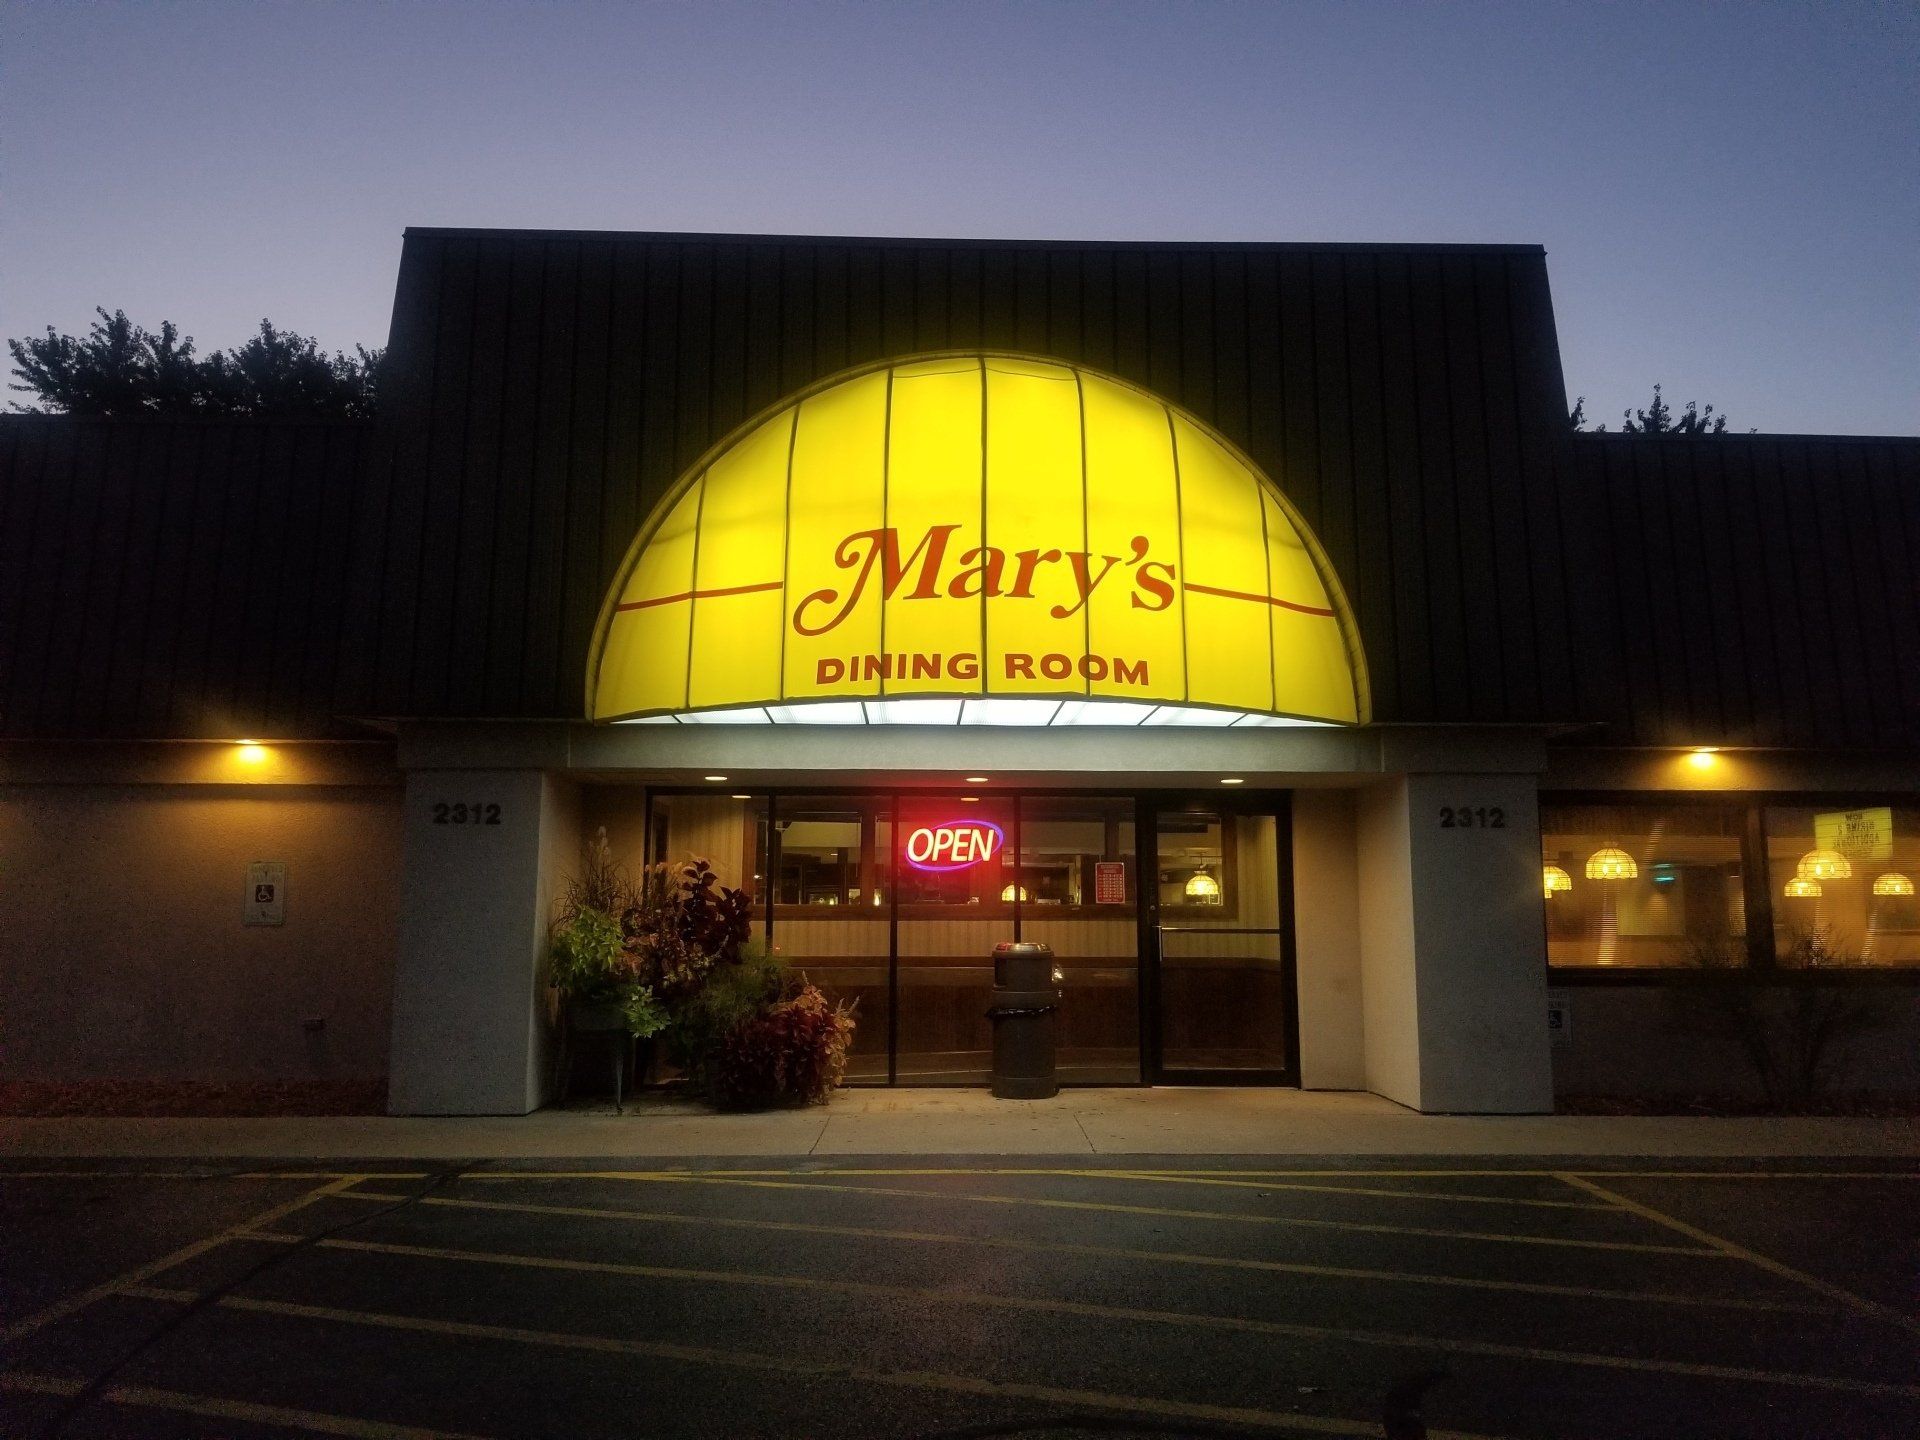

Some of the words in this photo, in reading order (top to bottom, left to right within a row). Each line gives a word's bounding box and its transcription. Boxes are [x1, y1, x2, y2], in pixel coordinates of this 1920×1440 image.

[792, 524, 1176, 637] Mary's
[816, 653, 979, 685] DINING
[1004, 653, 1150, 686] ROOM
[433, 802, 502, 825] 2312
[1439, 806, 1506, 828] 2312
[907, 828, 995, 862] OPEN
